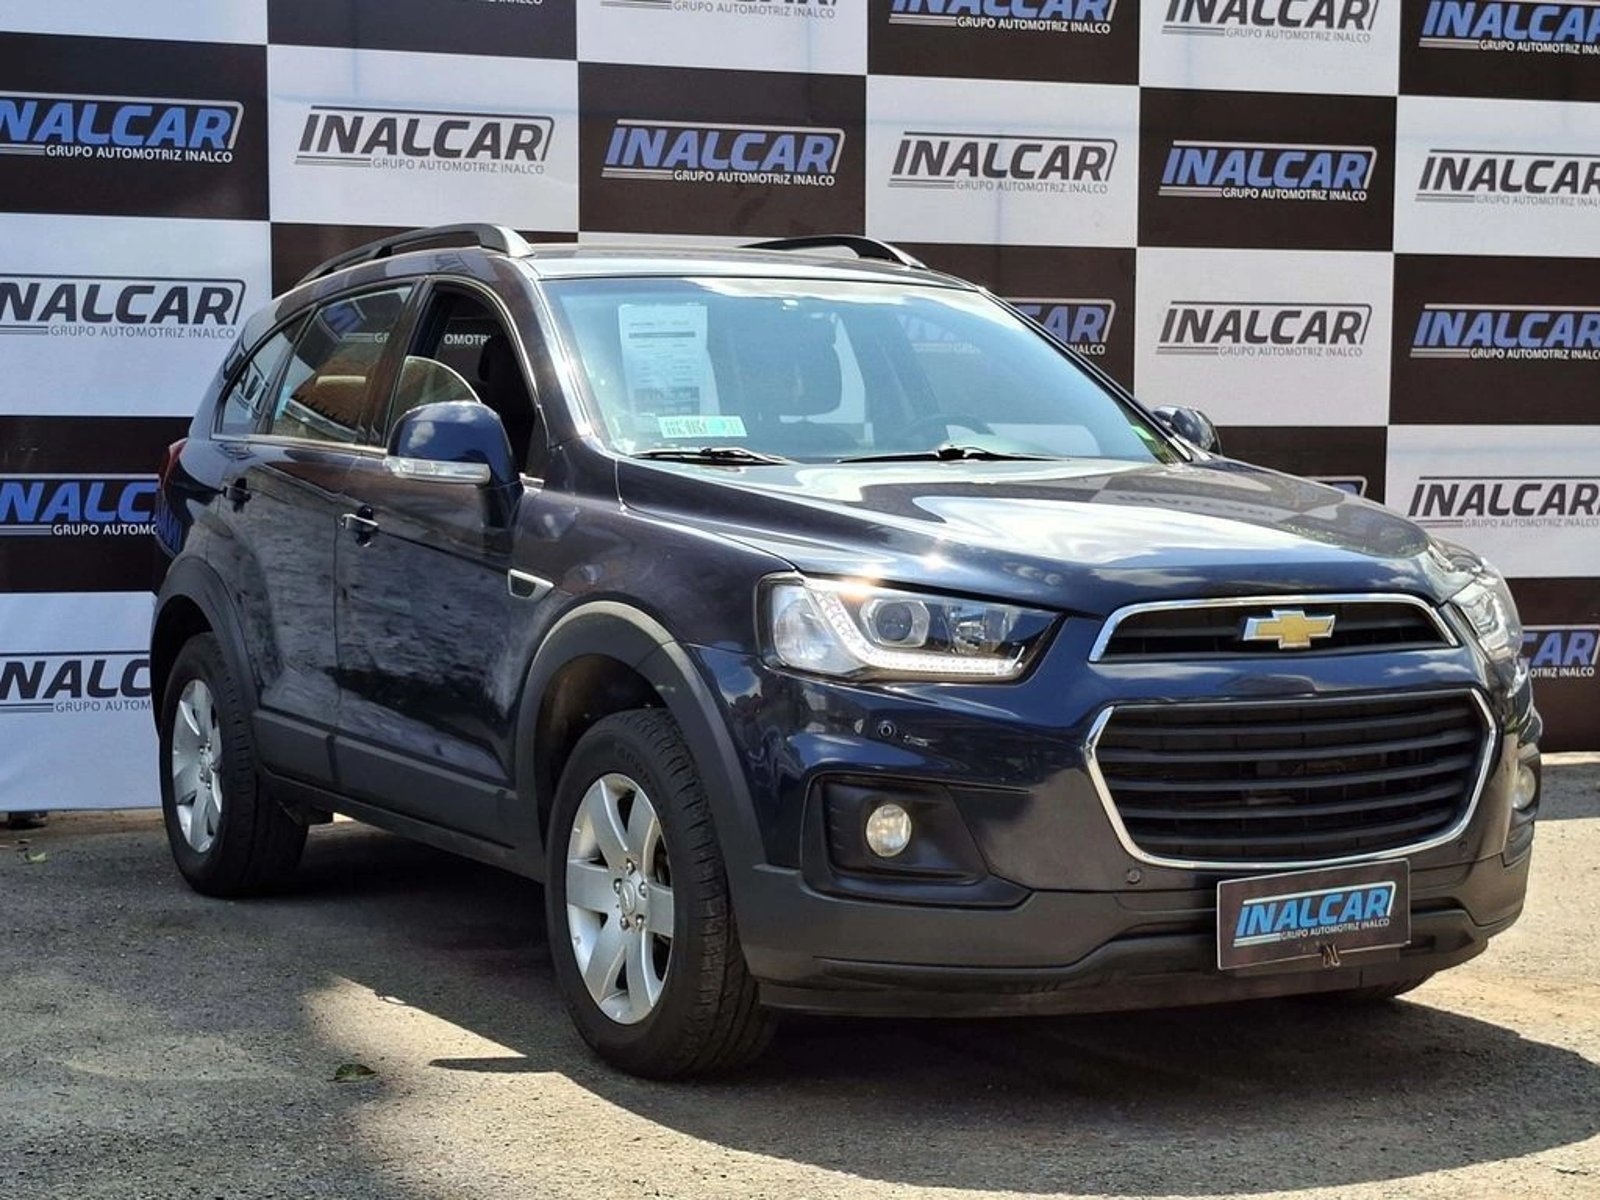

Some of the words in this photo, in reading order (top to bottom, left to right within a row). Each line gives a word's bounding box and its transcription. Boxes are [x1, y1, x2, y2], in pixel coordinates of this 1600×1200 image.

[673, 1, 714, 13] GRUPO
[717, 4, 791, 17] AUTOMOTRIZ
[793, 8, 835, 20] INALCO
[957, 16, 995, 29] GRUPO
[998, 18, 1067, 32] AUTOMOTRIZ
[1070, 21, 1110, 34] INALCO
[1225, 28, 1262, 39] GRUPO
[1265, 29, 1331, 42] AUTOMOTRIZ
[1333, 32, 1371, 44] INALCO
[1480, 39, 1514, 51] GRUPO
[1517, 41, 1580, 54] AUTOMOTRIZ
[298, 114, 543, 161] INALCAR
[46, 144, 93, 158] GRUPO
[96, 147, 182, 162] AUTOMOTRIZ
[185, 150, 233, 163] INALCO
[605, 127, 835, 173] INALCAR
[373, 157, 415, 170] GRUPO
[418, 159, 498, 174] AUTOMOTRIZ
[500, 162, 545, 175] INALCO
[892, 139, 1107, 182] INALCAR
[1161, 148, 1368, 189] INALCAR
[673, 169, 714, 182] GRUPO
[716, 172, 791, 186] AUTOMOTRIZ
[793, 174, 835, 187] INALCO
[956, 179, 994, 190] GRUPO
[997, 181, 1066, 193] AUTOMOTRIZ
[1069, 184, 1109, 194] INALCO
[1222, 187, 1259, 199] GRUPO
[1261, 188, 1328, 201] AUTOMOTRIZ
[1329, 189, 1367, 201] INALCO
[50, 325, 97, 337] GRUPO
[100, 326, 185, 339] AUTOMOTRIZ
[188, 327, 237, 340] INALCO
[1159, 308, 1362, 345] INALCAR
[1413, 311, 1600, 348] INALCAR
[1219, 346, 1255, 357] GRUPO
[1257, 346, 1323, 357] AUTOMOTRIZ
[1325, 346, 1363, 357] INALCO
[1471, 348, 1505, 359] GRUPO
[1507, 348, 1569, 360] AUTOMOTRIZ
[1408, 483, 1599, 516] INALCAR
[52, 524, 99, 536] GRUPO
[1463, 518, 1498, 528] GRUPO
[1500, 518, 1562, 528] AUTOMOTRIZ
[1564, 518, 1599, 528] INALCO
[1559, 666, 1595, 677] INALCO
[55, 701, 101, 713] GRUPO
[1235, 888, 1389, 937] INALCAR
[1281, 926, 1309, 940] GRUPO
[1310, 922, 1359, 937] AUTOMOTRIZ
[1361, 918, 1390, 930] INALCO
